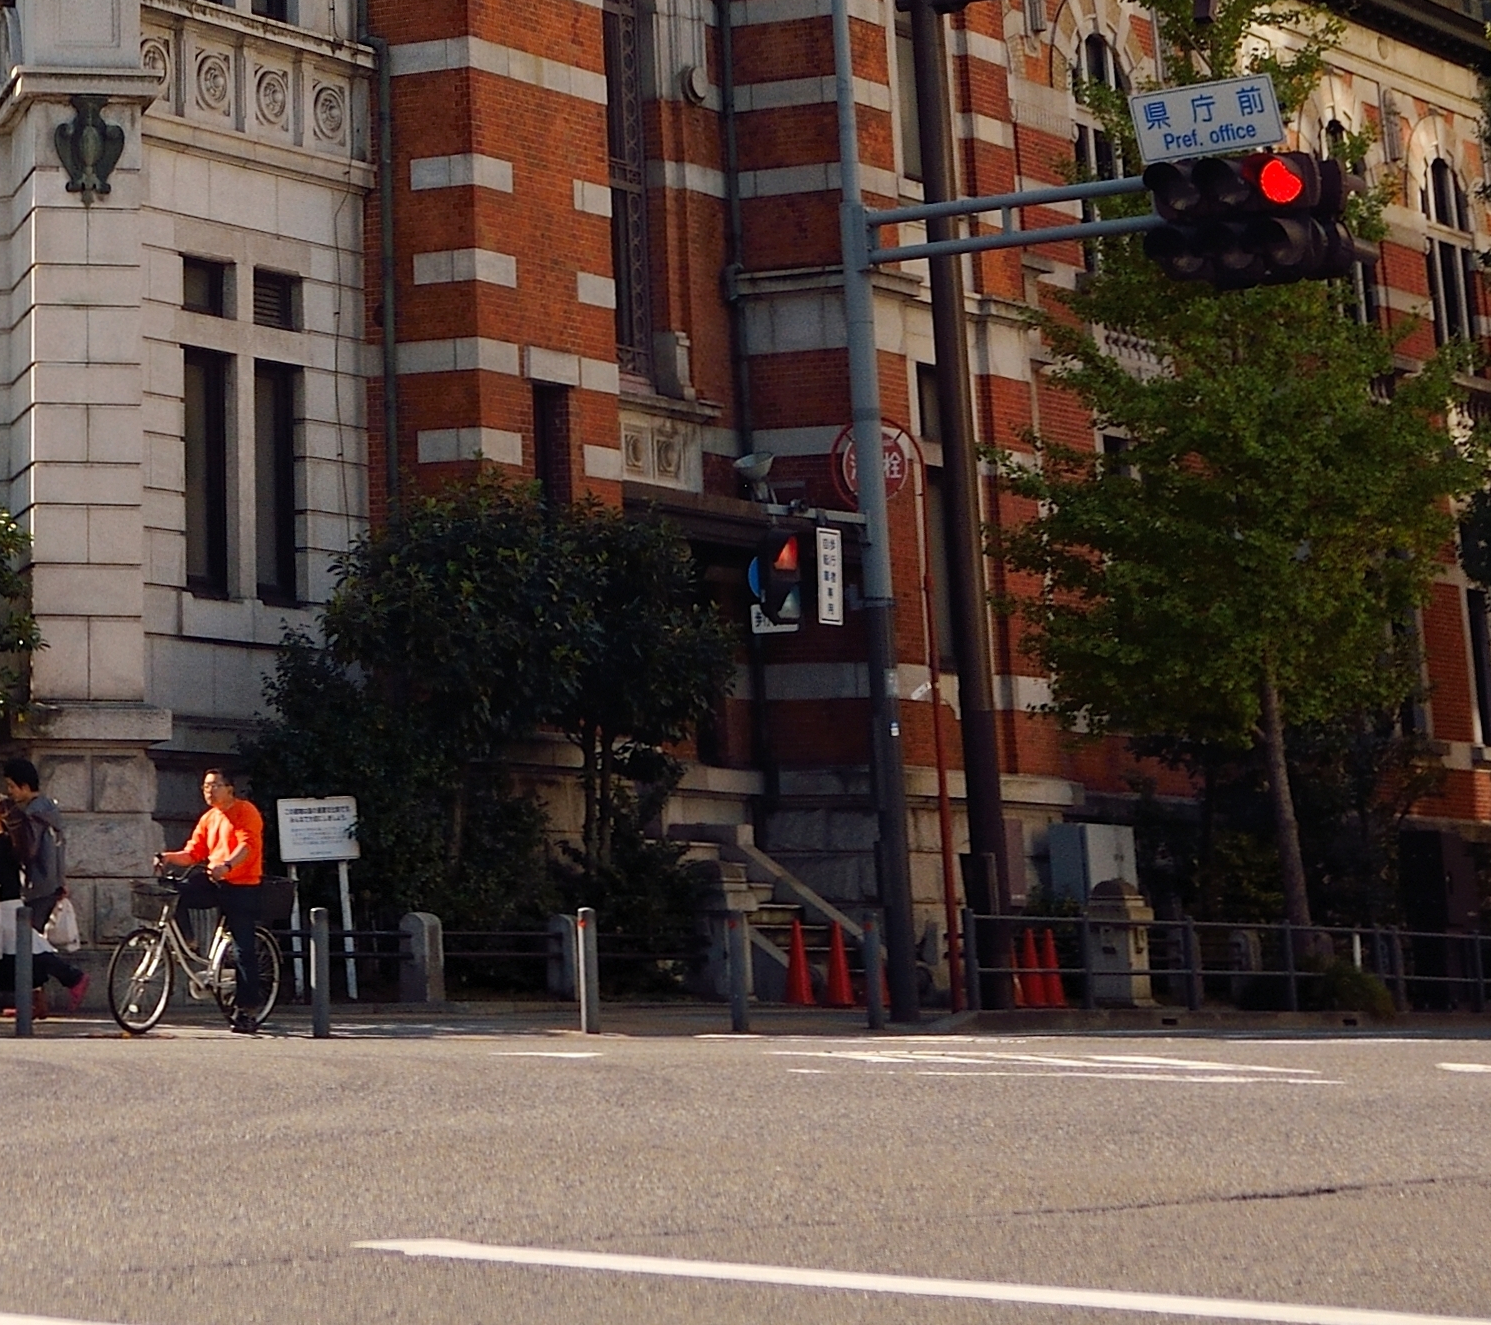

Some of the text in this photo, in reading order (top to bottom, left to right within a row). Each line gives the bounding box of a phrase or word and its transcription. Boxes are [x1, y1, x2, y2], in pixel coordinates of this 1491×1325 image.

[1143, 87, 1266, 130] 県庁前
[1164, 123, 1257, 150] Pref. office
